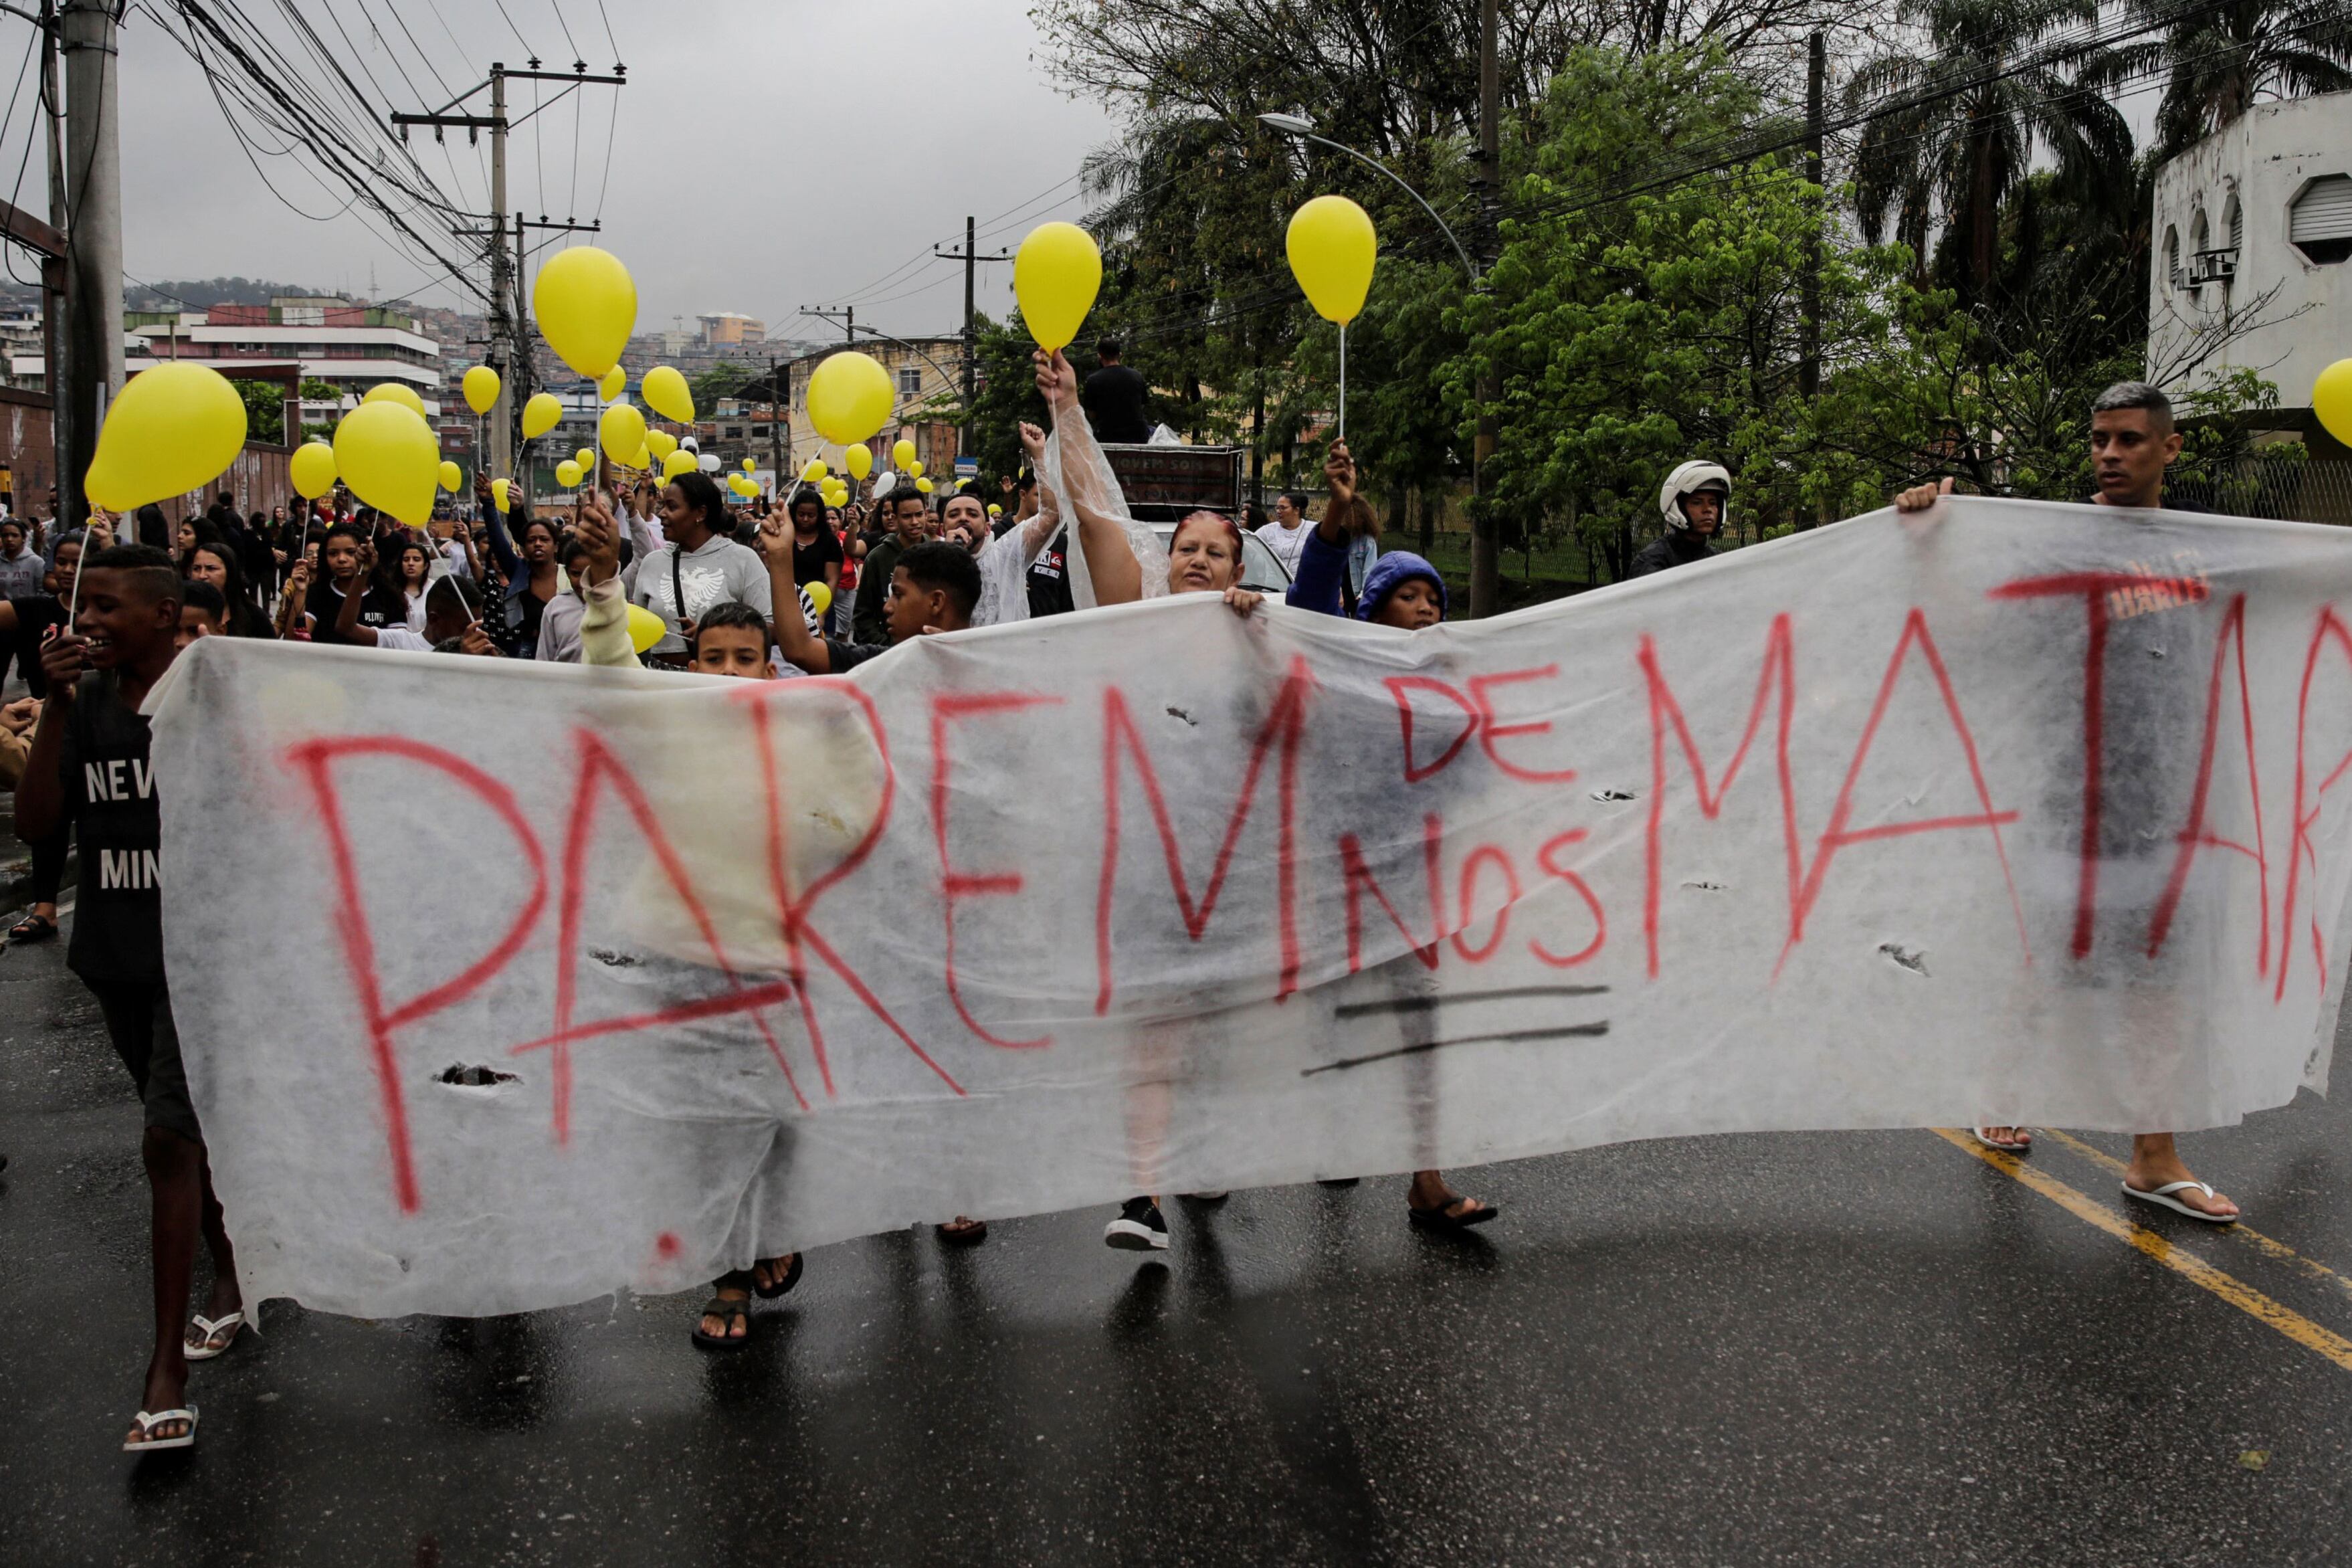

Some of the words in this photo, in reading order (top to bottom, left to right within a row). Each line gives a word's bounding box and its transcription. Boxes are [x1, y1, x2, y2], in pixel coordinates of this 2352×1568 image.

[85, 759, 155, 803] NEV
[1383, 664, 1576, 783] DE
[1636, 571, 2352, 1003] MATAR
[101, 849, 161, 889] MIN
[280, 653, 1314, 1214] PAREM
[1341, 812, 1605, 974] NOS
